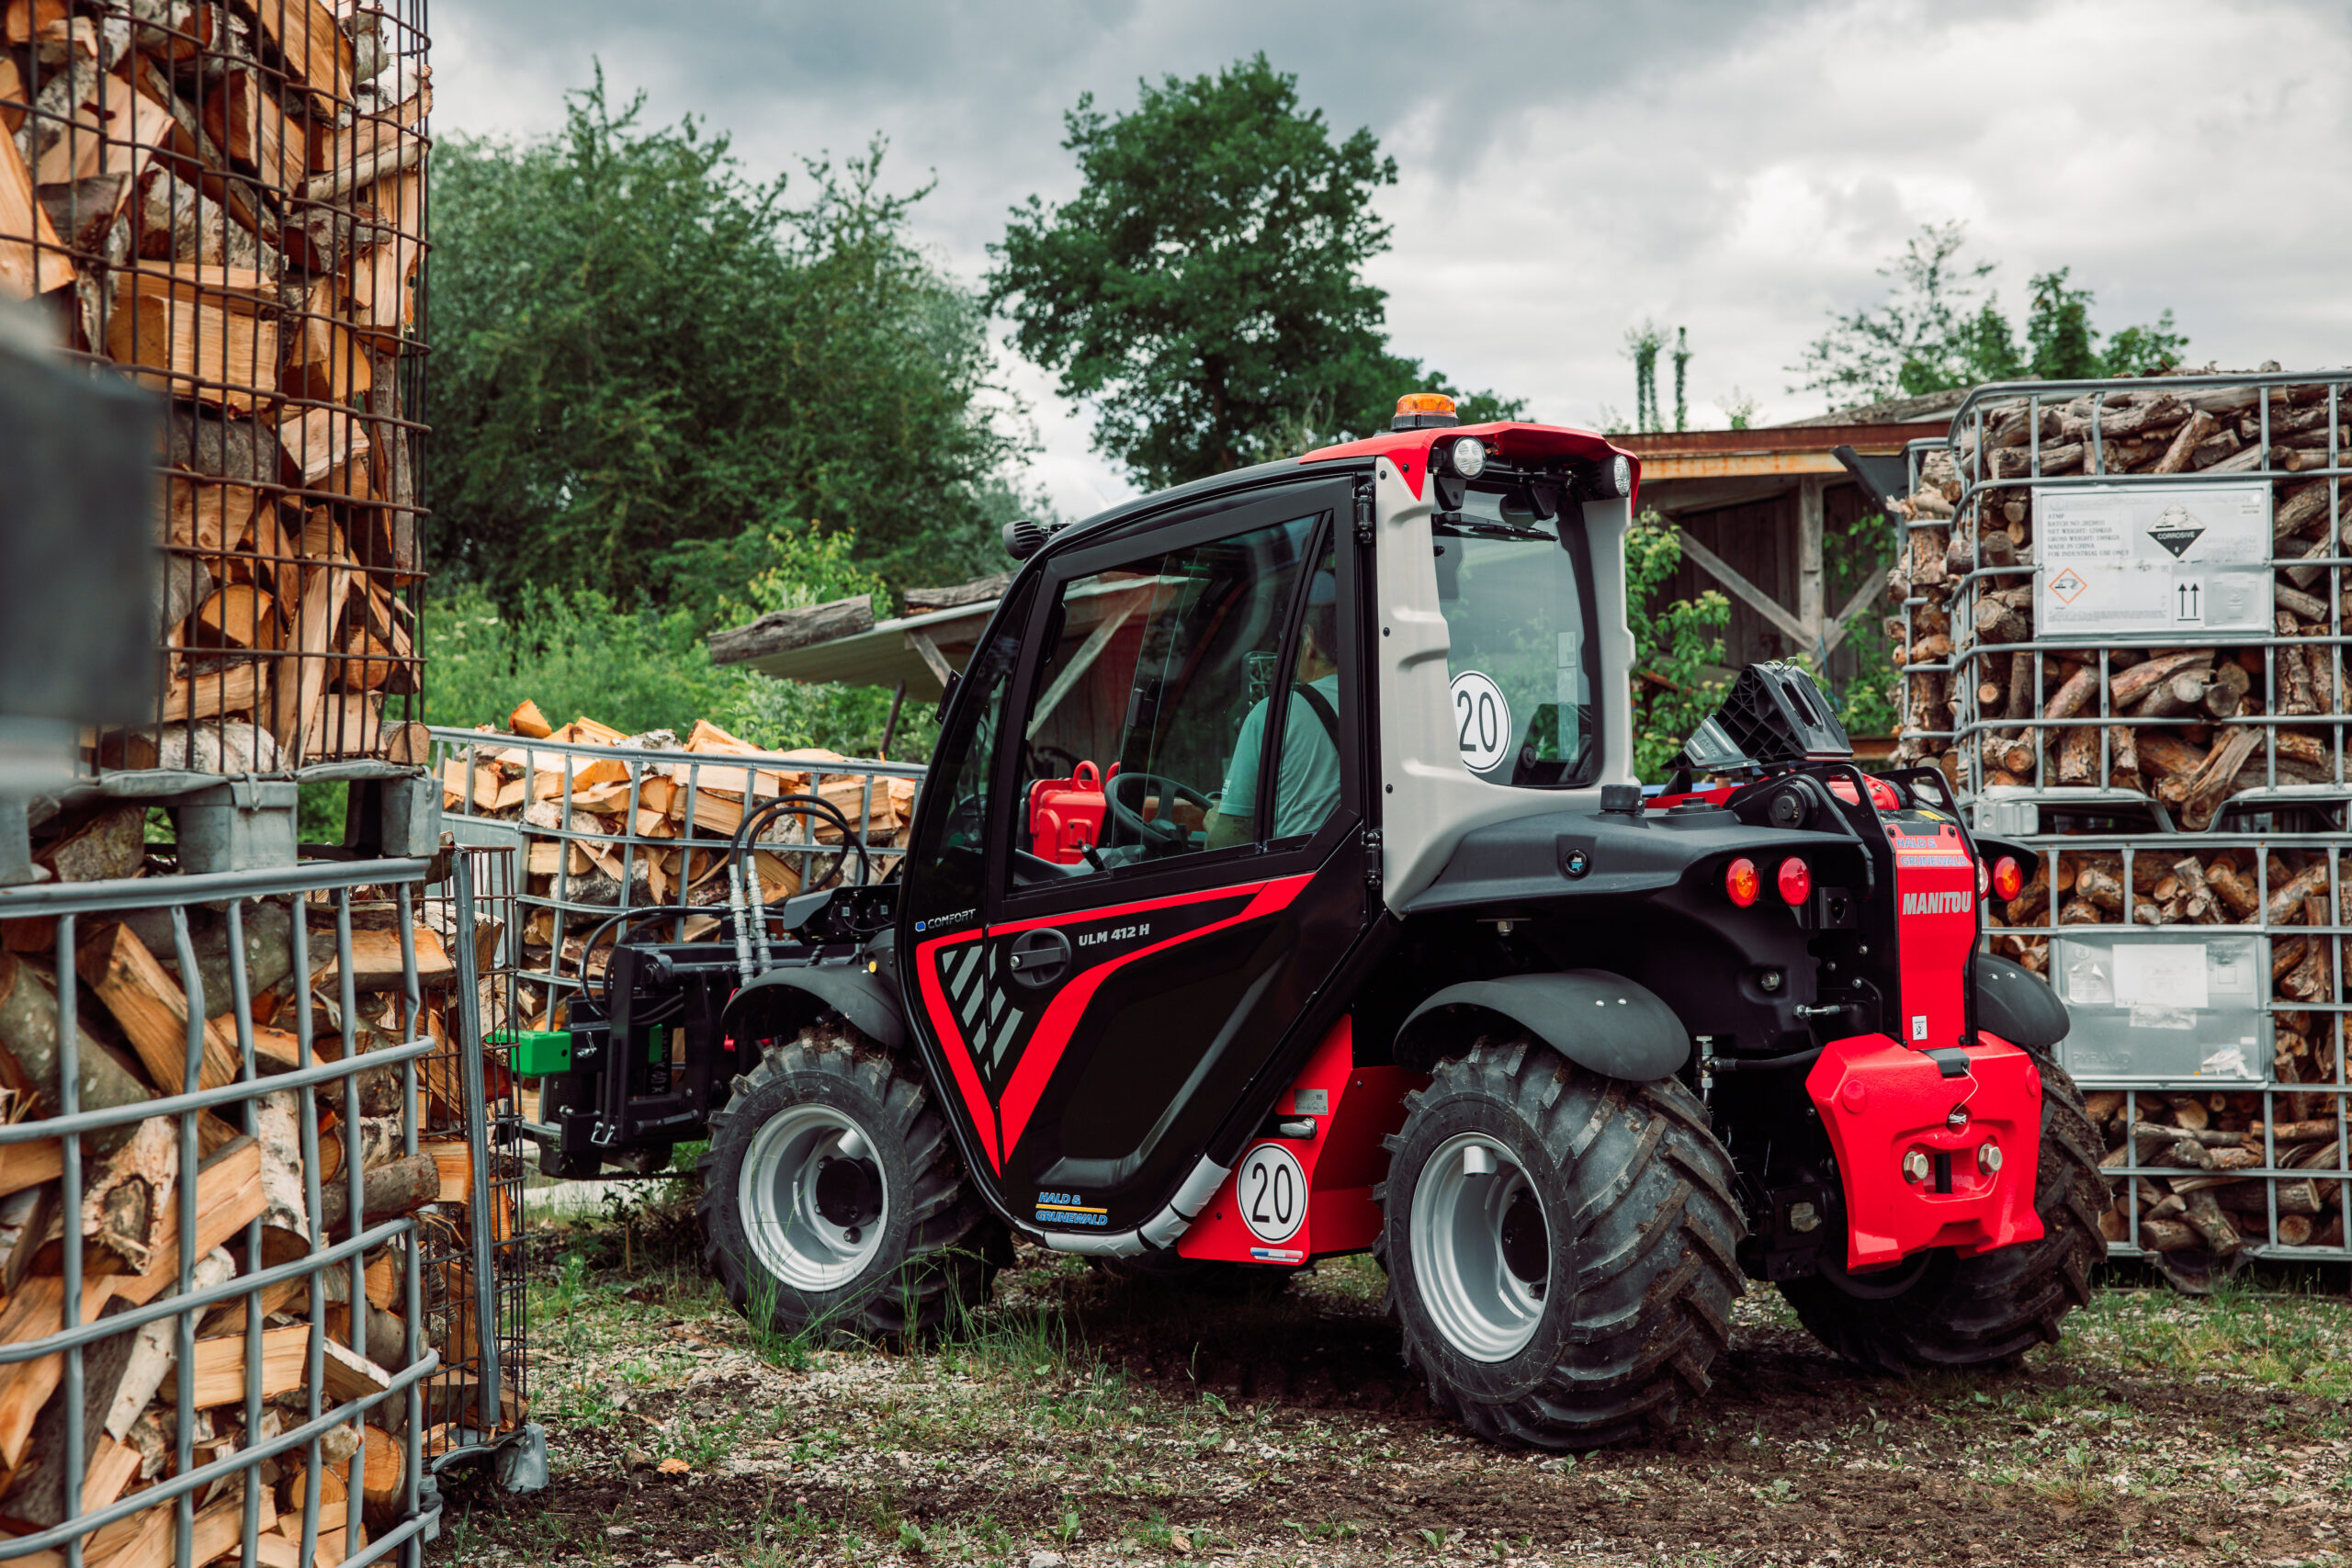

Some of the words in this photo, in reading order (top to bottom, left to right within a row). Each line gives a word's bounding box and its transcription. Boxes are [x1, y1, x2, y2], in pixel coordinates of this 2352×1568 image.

[2157, 531, 2196, 540] CORROSIVE
[1457, 690, 1497, 752] 20
[1896, 838, 1926, 848] HALD
[1928, 838, 1937, 848] &
[1900, 855, 1967, 866] GRUNEWALD
[1902, 891, 1973, 916] MANITOU
[927, 908, 977, 930] COMFORT
[1078, 931, 1108, 947] ULM
[1111, 925, 1136, 941] 412
[1138, 923, 1150, 936] H
[1038, 1191, 1071, 1204] HALD
[1071, 1194, 1081, 1205] &
[1251, 1162, 1293, 1224] 20
[1035, 1210, 1108, 1226] GRUNEWALD
